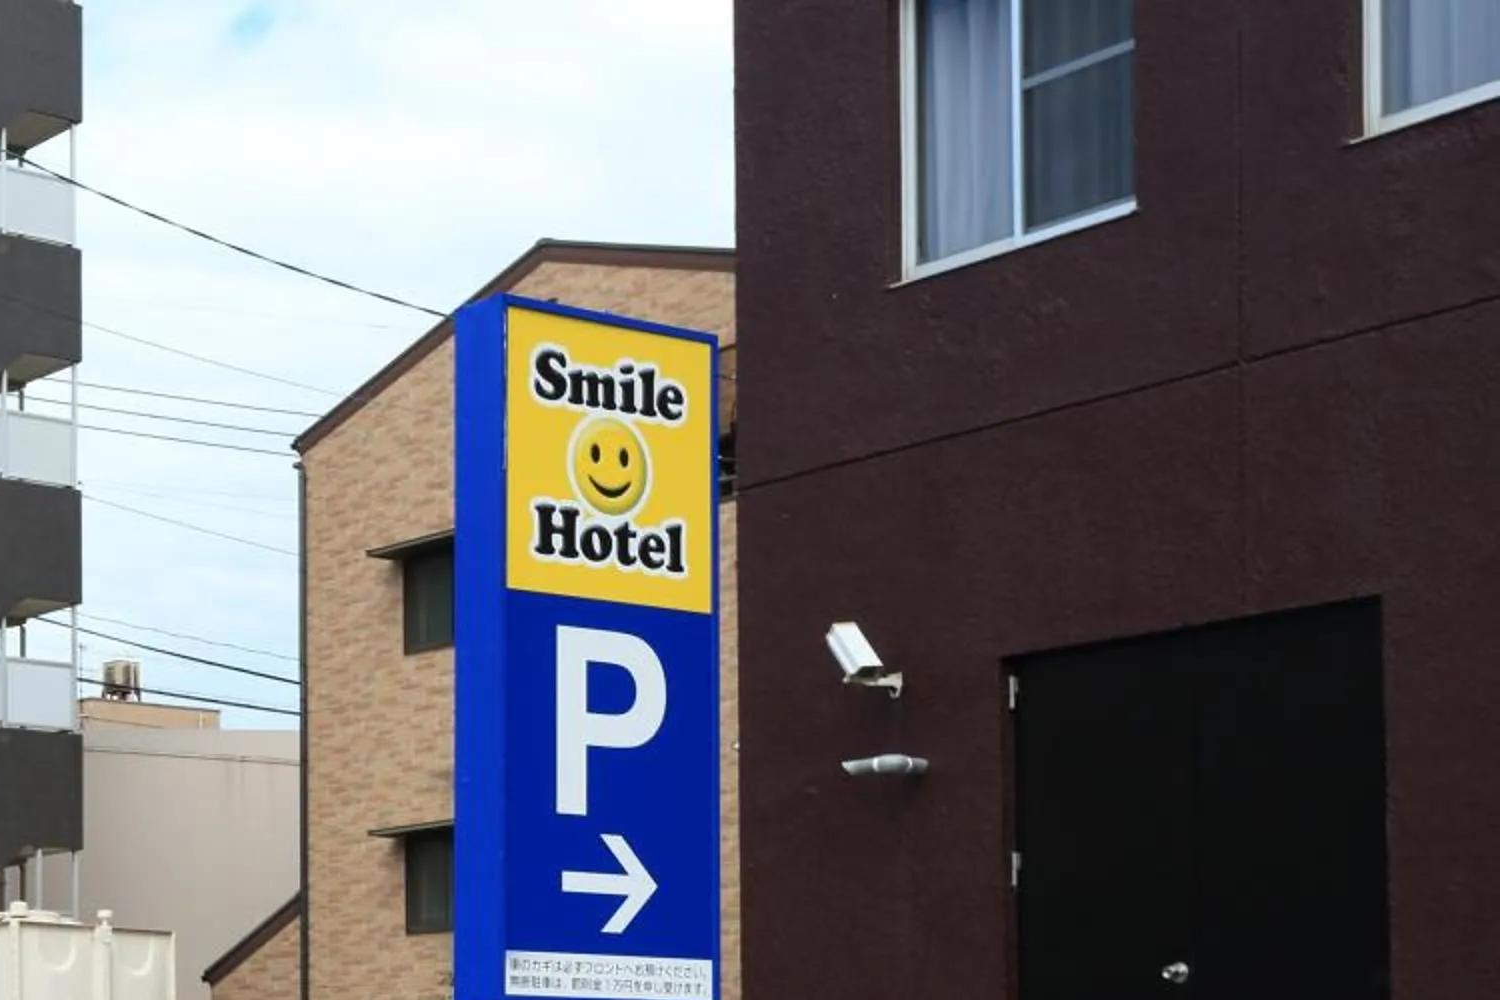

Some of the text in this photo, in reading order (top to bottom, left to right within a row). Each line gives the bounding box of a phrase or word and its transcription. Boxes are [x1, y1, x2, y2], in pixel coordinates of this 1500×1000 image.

[534, 350, 684, 421] Smile
[534, 503, 685, 572] Hotel
[556, 624, 667, 816] P
